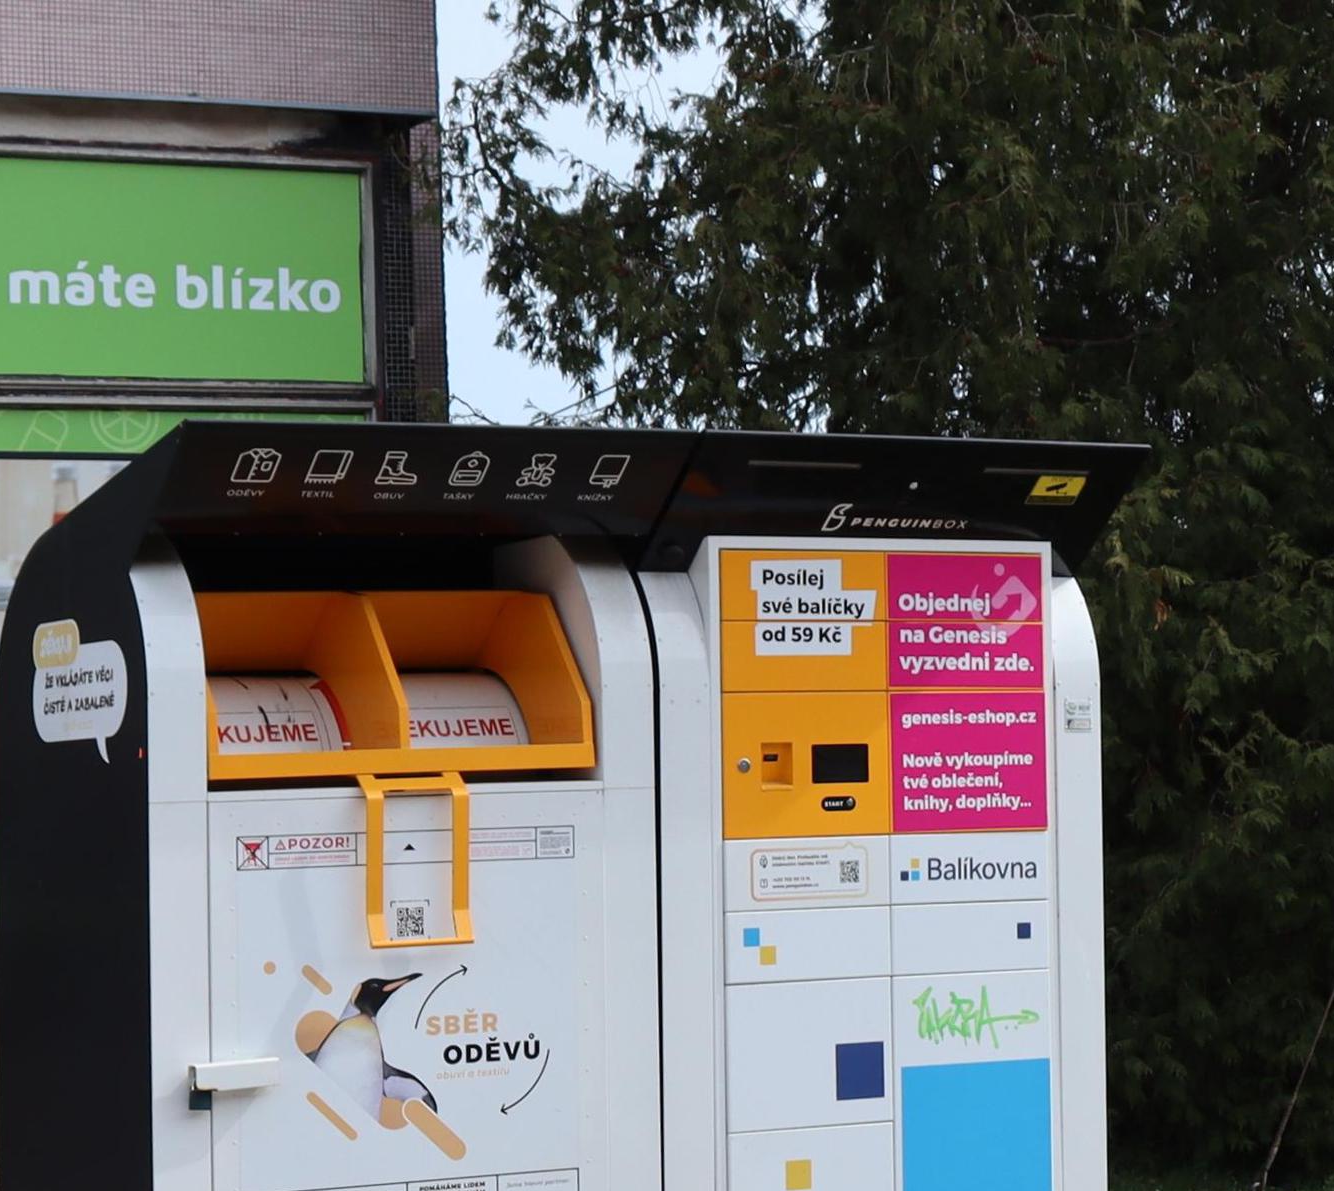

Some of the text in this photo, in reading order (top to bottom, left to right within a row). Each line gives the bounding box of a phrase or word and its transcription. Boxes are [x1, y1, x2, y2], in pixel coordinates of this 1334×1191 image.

[8, 260, 156, 308] máte
[175, 264, 342, 313] blízko
[300, 490, 335, 498] TEXTIL
[373, 492, 405, 500] OBUV
[850, 517, 969, 530] PENGUINBOX
[762, 568, 824, 590] Posílej
[762, 597, 865, 619] své balíčky
[898, 592, 991, 616] Objednej
[762, 626, 842, 643] od 59 Kč
[899, 625, 1008, 644] na Genesis
[899, 651, 1035, 675] vyzvedni zde.
[45, 672, 54, 689] ŽE
[67, 699, 73, 711] A
[901, 709, 1037, 729] genesis-eshop.cz
[902, 751, 1033, 770] Nově vykoupíme
[902, 772, 1004, 790] tvé oblečení,
[903, 793, 1032, 812] knihy, doplňky...
[287, 836, 350, 850] POZOR!
[927, 857, 1037, 881] Balíkovna
[425, 1008, 498, 1036] SBĚR
[443, 1032, 540, 1065] ODĚVŮ
[463, 1181, 486, 1190] LIDEM
